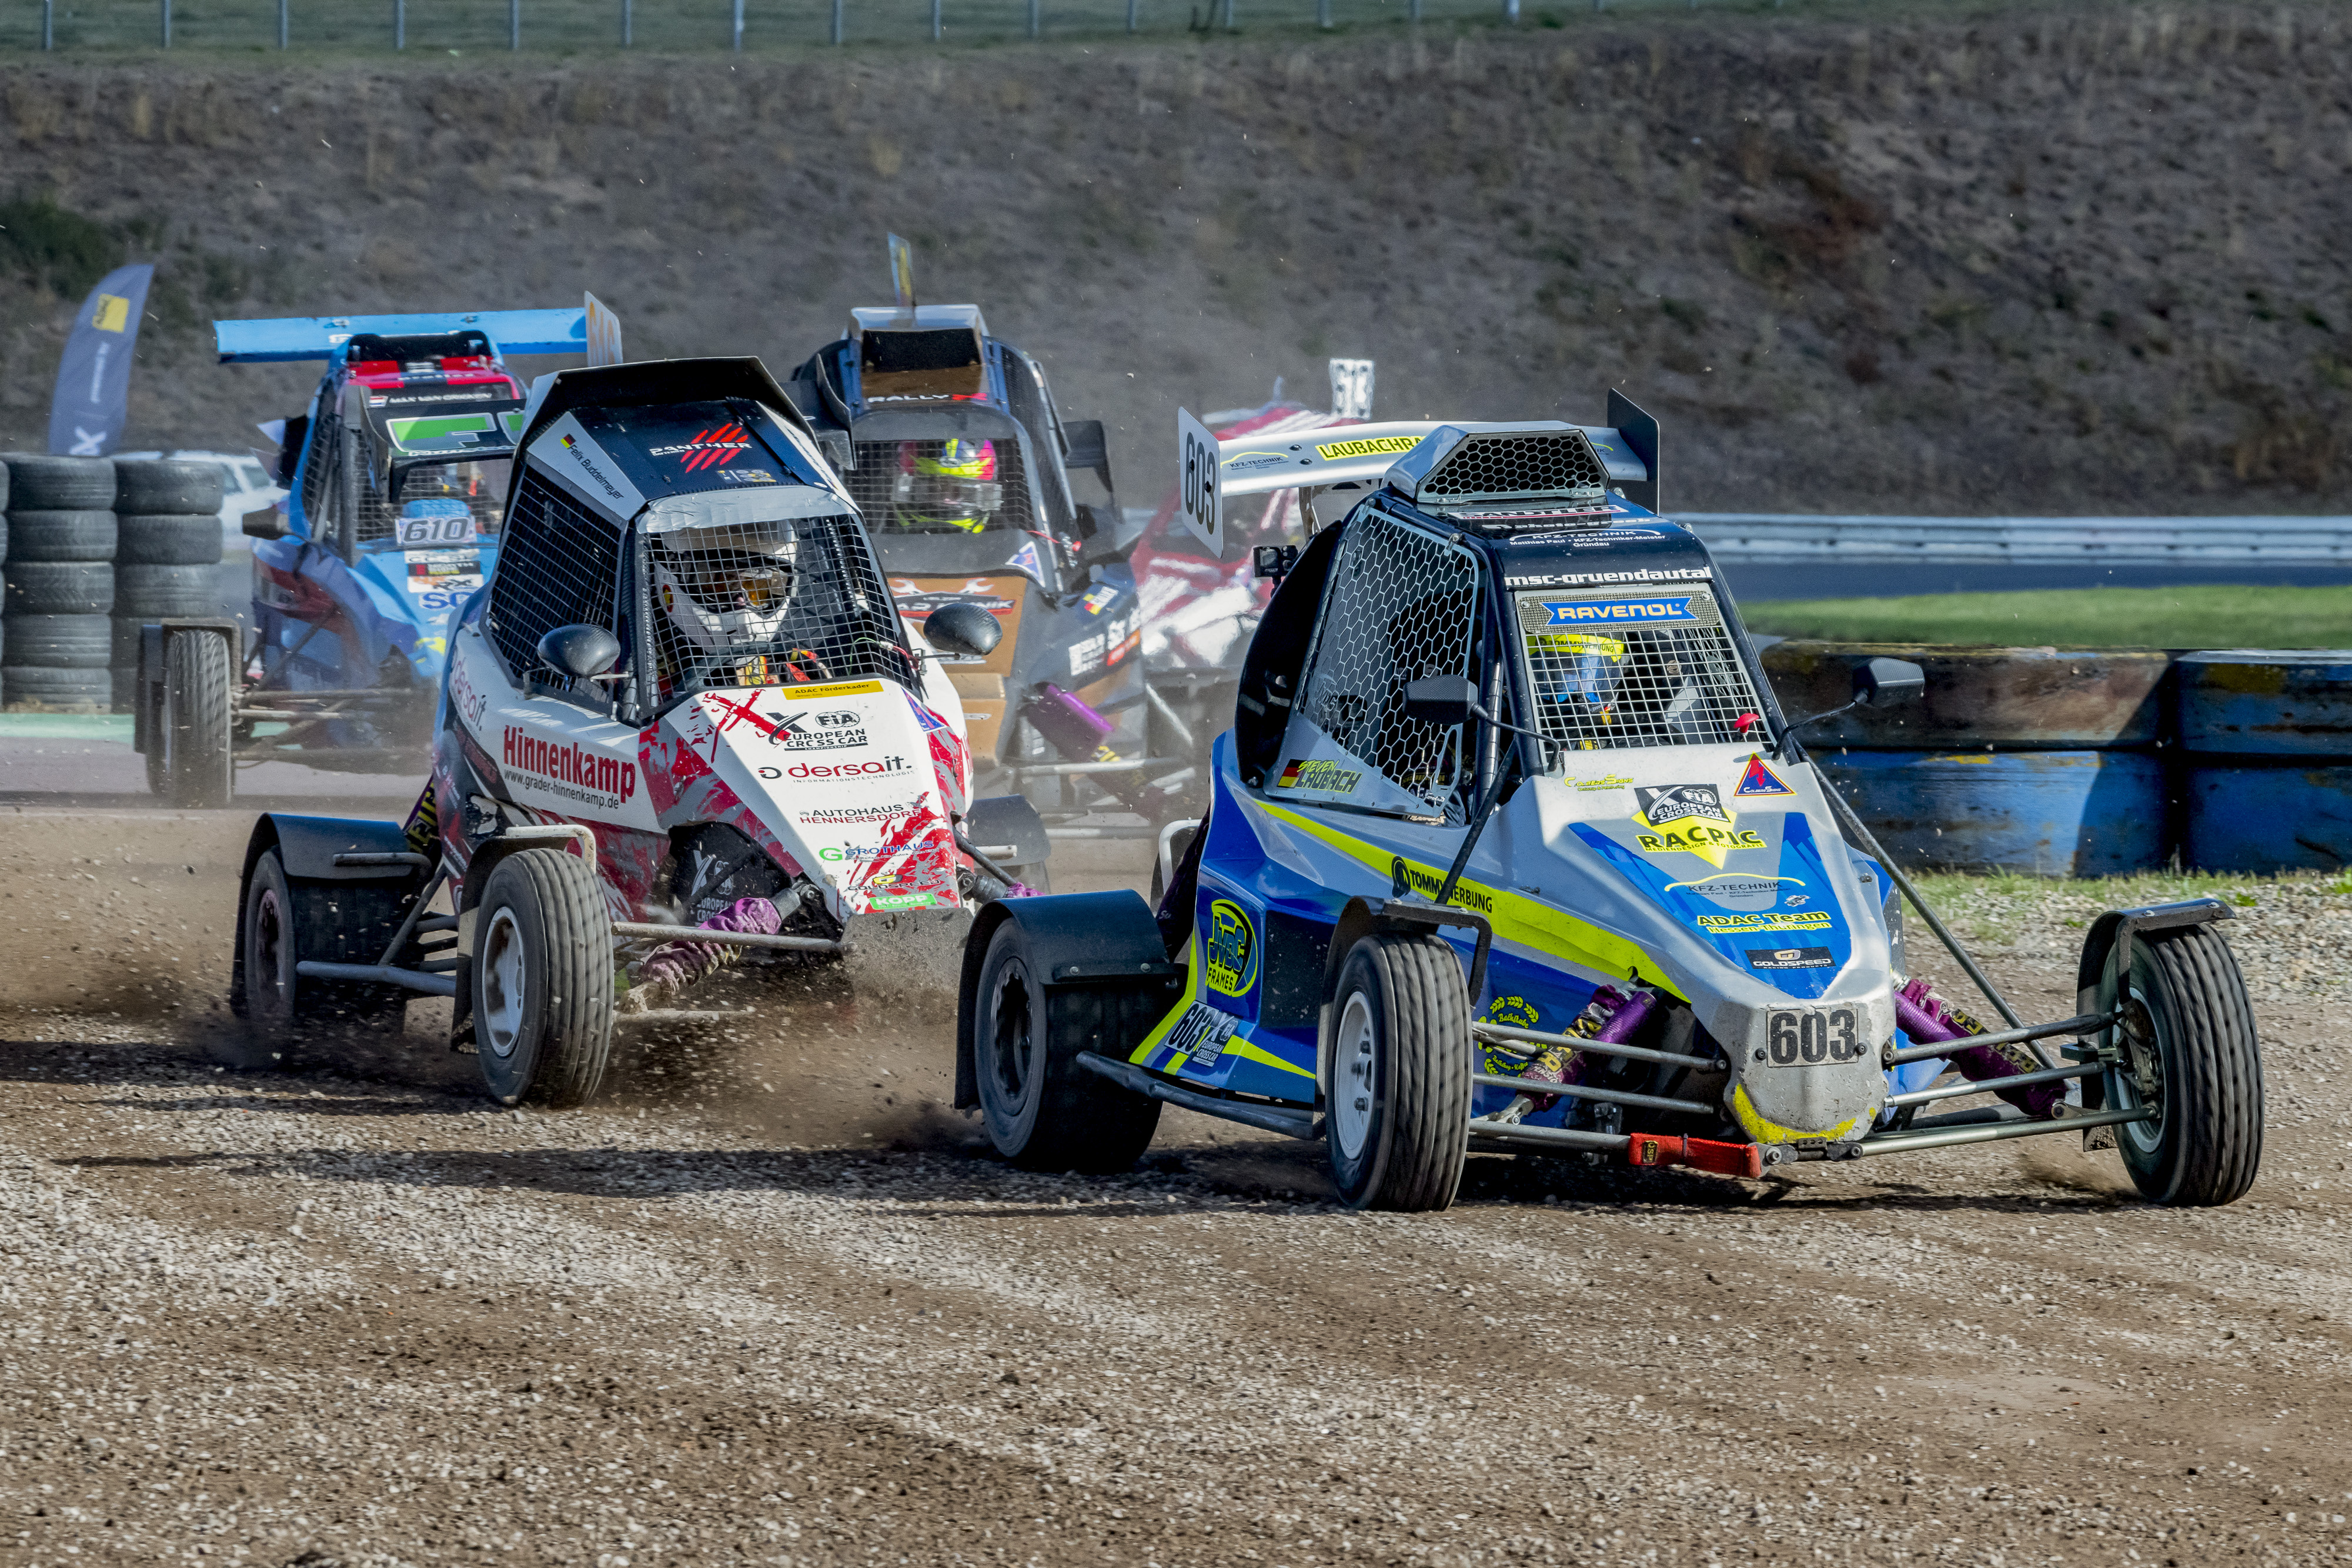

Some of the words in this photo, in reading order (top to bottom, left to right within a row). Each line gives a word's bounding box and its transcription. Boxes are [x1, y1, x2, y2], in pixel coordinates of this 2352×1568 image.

[649, 442, 753, 454] PANTHER
[1230, 457, 1283, 467] KFZ-TECHNIK
[567, 444, 584, 462] Felix
[580, 459, 625, 499] Buddelmeyer
[1185, 432, 1216, 534] 603
[403, 518, 469, 542] 610
[1532, 531, 1637, 539] KFZ-TECHNIK
[1557, 603, 1682, 619] RAVENOL
[820, 683, 870, 693] Förderkader
[784, 728, 866, 741] EUROPEAN
[838, 735, 868, 744] CAR
[503, 724, 636, 804] Hinnenkamp
[1297, 760, 1340, 773] STEVEN
[1295, 768, 1363, 793] LAUBACH
[504, 769, 619, 810] www.grader-hinnenkamp.de
[813, 804, 904, 816] AUTOHAUS
[1656, 802, 1721, 814] EUROPEAN
[1659, 808, 1699, 820] CROSS
[1700, 810, 1723, 818] CAR
[800, 810, 921, 824] HENNERSDORF
[1638, 827, 1762, 848] RACPIC
[846, 841, 934, 855] GROTHAUS
[1645, 841, 1706, 851] MEDIENDESIGN
[847, 879, 940, 891] GOLDSPEED
[1688, 881, 1782, 892] KFZ-TECHNIK
[875, 895, 928, 905] KOPP
[1698, 914, 1762, 926] ADAC
[1764, 911, 1830, 923] Team
[1752, 958, 1832, 967] GOLDSPEED
[1207, 967, 1234, 991] FRAMES
[1770, 1009, 1856, 1065] 603
